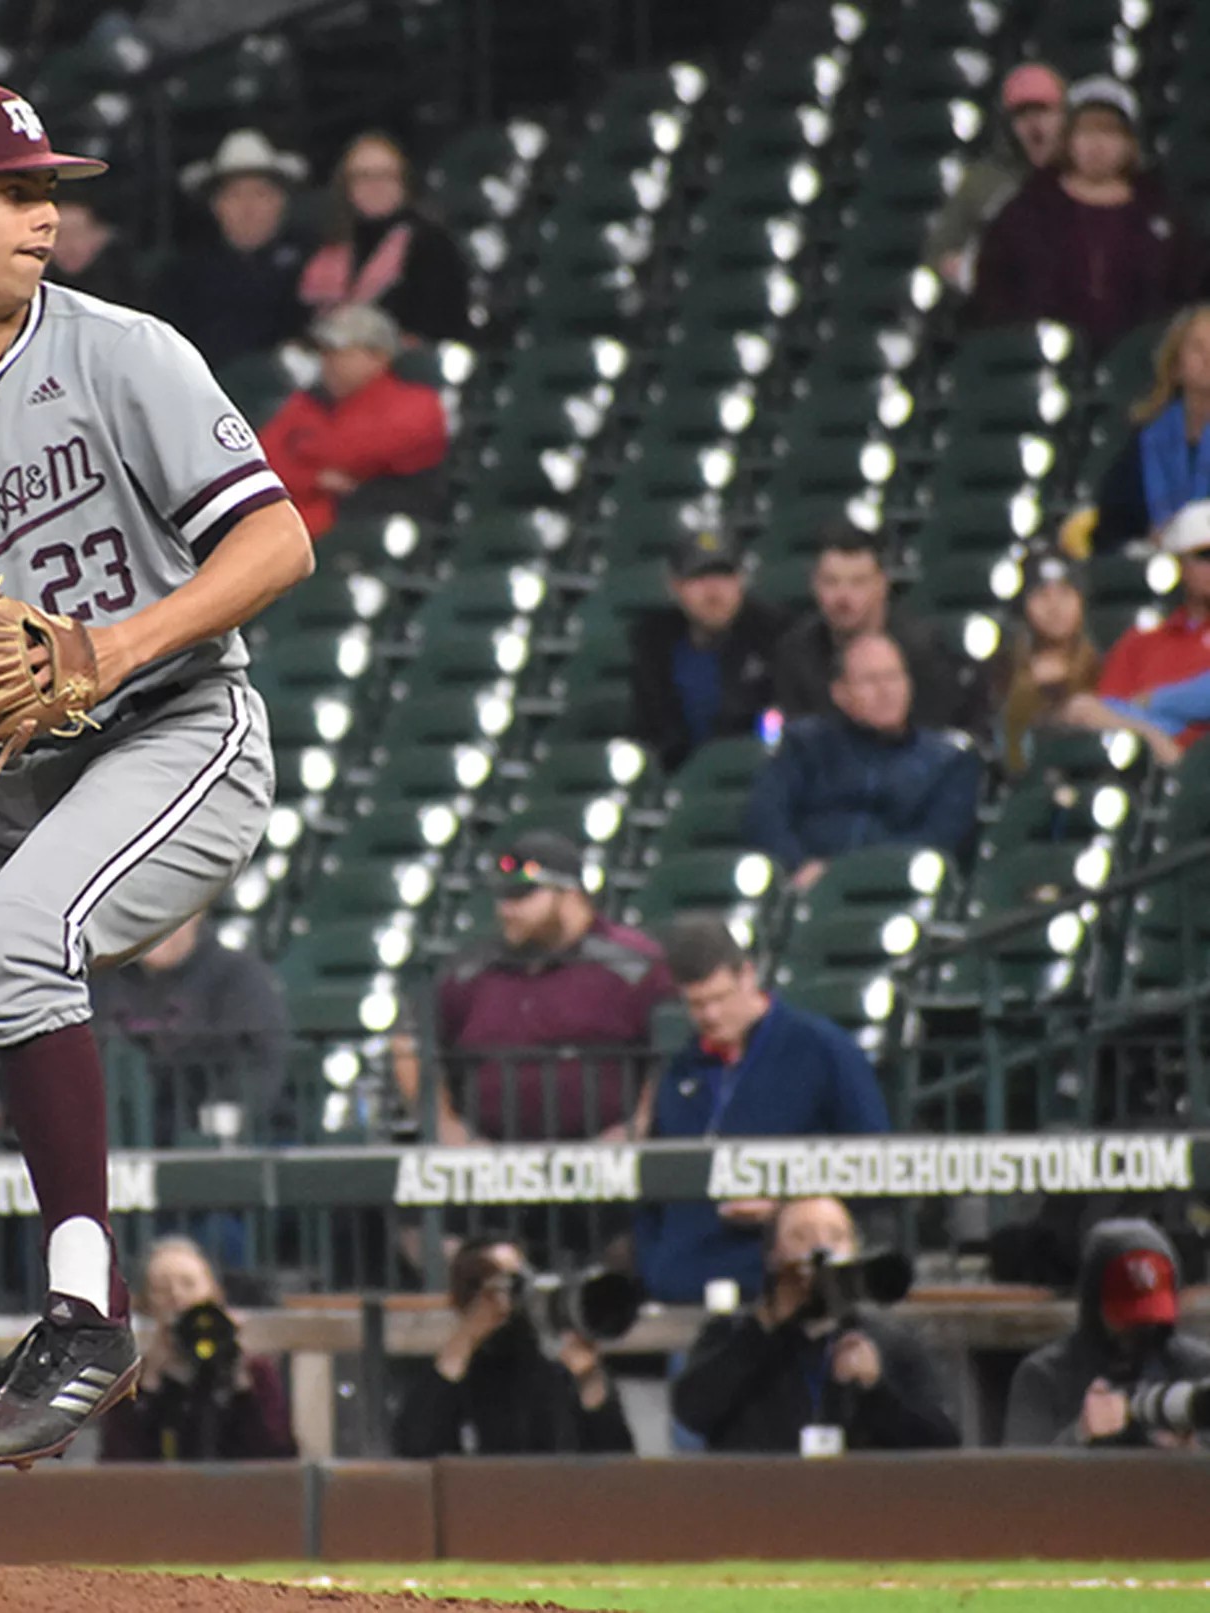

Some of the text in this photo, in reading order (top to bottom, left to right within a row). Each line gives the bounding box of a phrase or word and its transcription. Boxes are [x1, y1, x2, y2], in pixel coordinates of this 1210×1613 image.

[30, 526, 136, 622] 23
[394, 1135, 1191, 1204] ASTROS.COM ASTROSDEHOUSTON.COM
